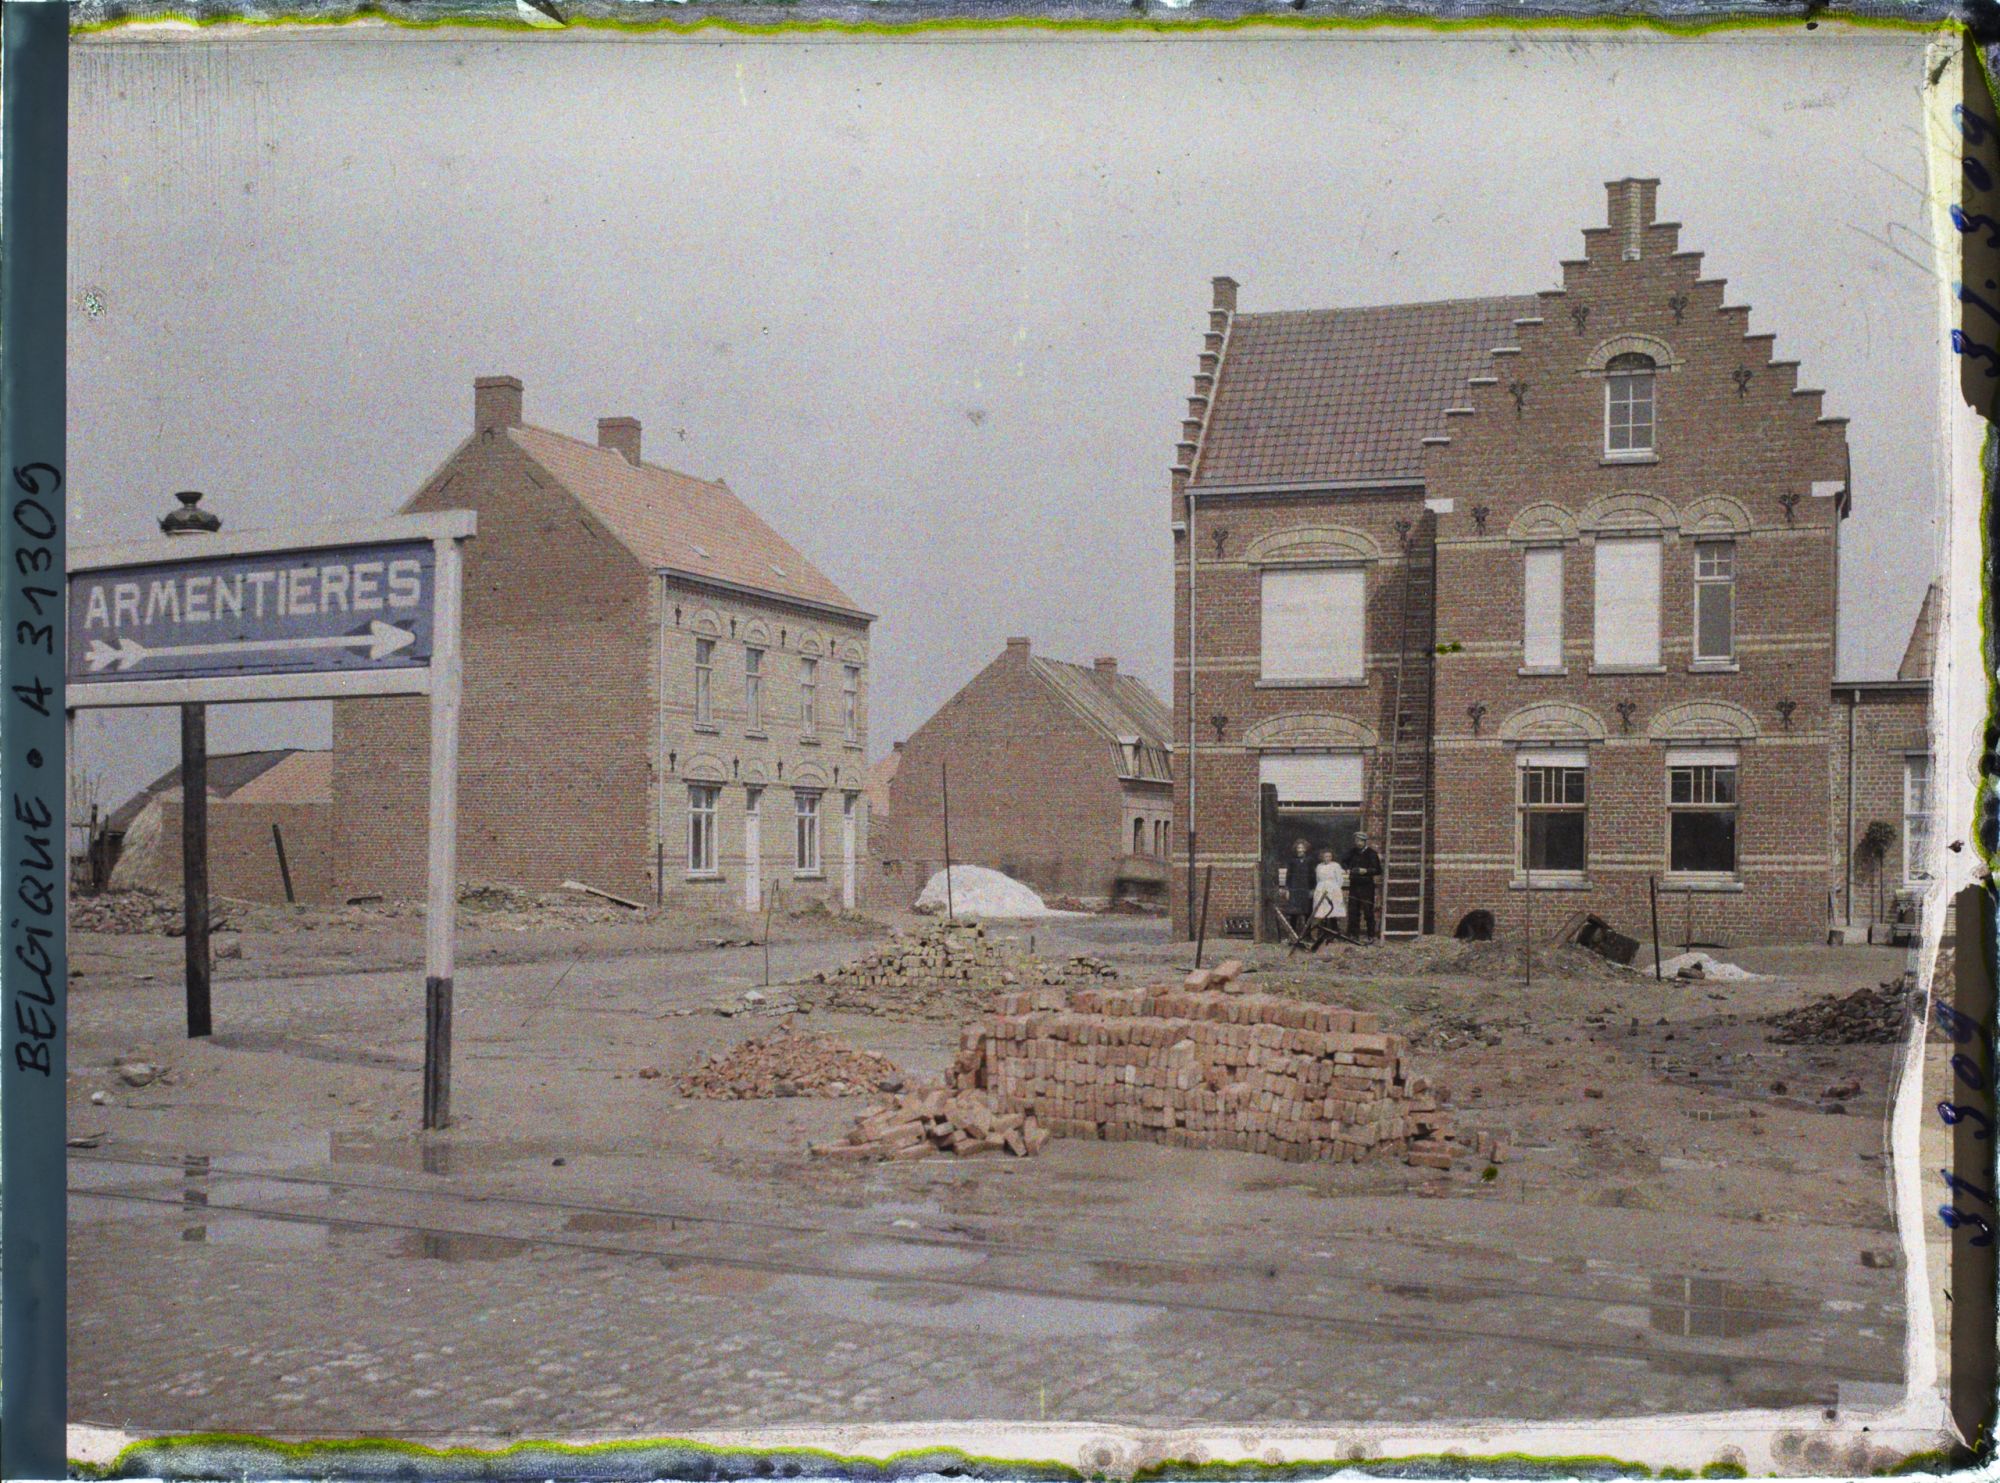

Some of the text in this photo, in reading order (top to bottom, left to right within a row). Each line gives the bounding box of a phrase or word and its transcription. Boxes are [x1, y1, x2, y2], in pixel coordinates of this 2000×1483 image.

[12, 461, 61, 655] 31309
[84, 559, 422, 629] ARMENTIERES
[12, 675, 53, 716] A
